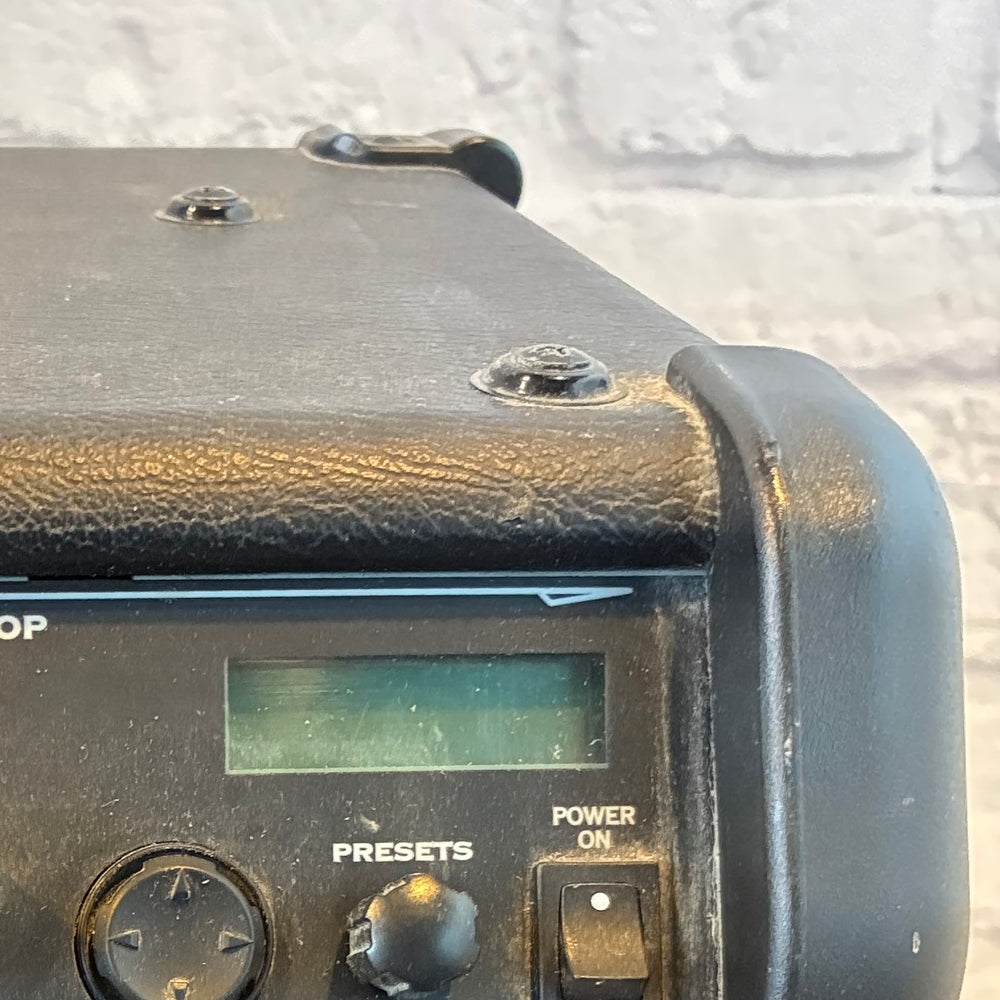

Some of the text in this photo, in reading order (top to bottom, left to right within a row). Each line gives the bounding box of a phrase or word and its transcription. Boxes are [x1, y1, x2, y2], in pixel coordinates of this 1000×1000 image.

[552, 805, 636, 826] POWER
[577, 830, 611, 850] ON
[332, 841, 474, 863] PRESETS
